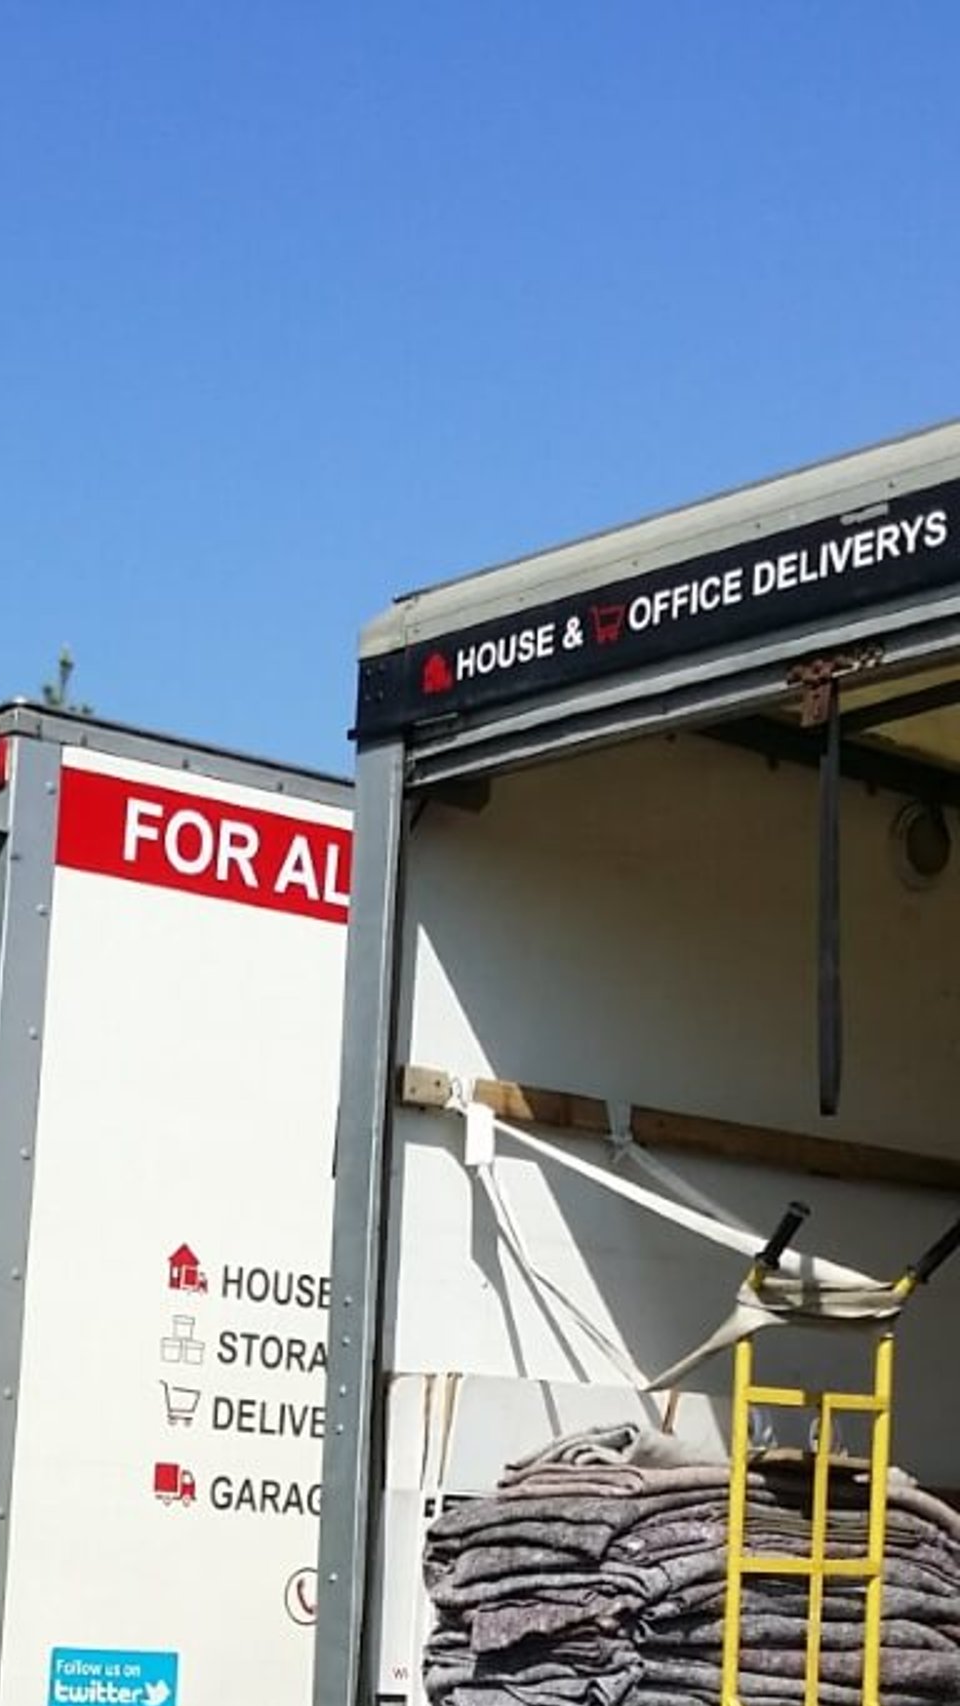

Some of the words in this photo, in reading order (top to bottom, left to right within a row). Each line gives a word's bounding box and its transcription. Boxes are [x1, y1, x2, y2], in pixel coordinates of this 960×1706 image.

[456, 623, 556, 681] HOUSE
[562, 616, 583, 650] &
[628, 568, 743, 632] OFFICE
[752, 510, 948, 597] DELIVERYS
[123, 796, 260, 888] FOR
[274, 834, 350, 907] AL
[221, 1265, 332, 1310] HOUSE
[216, 1331, 329, 1375] STORA
[211, 1396, 326, 1439] DELIVE
[56, 1659, 102, 1676] Follow
[104, 1663, 121, 1677] us
[122, 1663, 141, 1678] on
[54, 1679, 143, 1704] twitter
